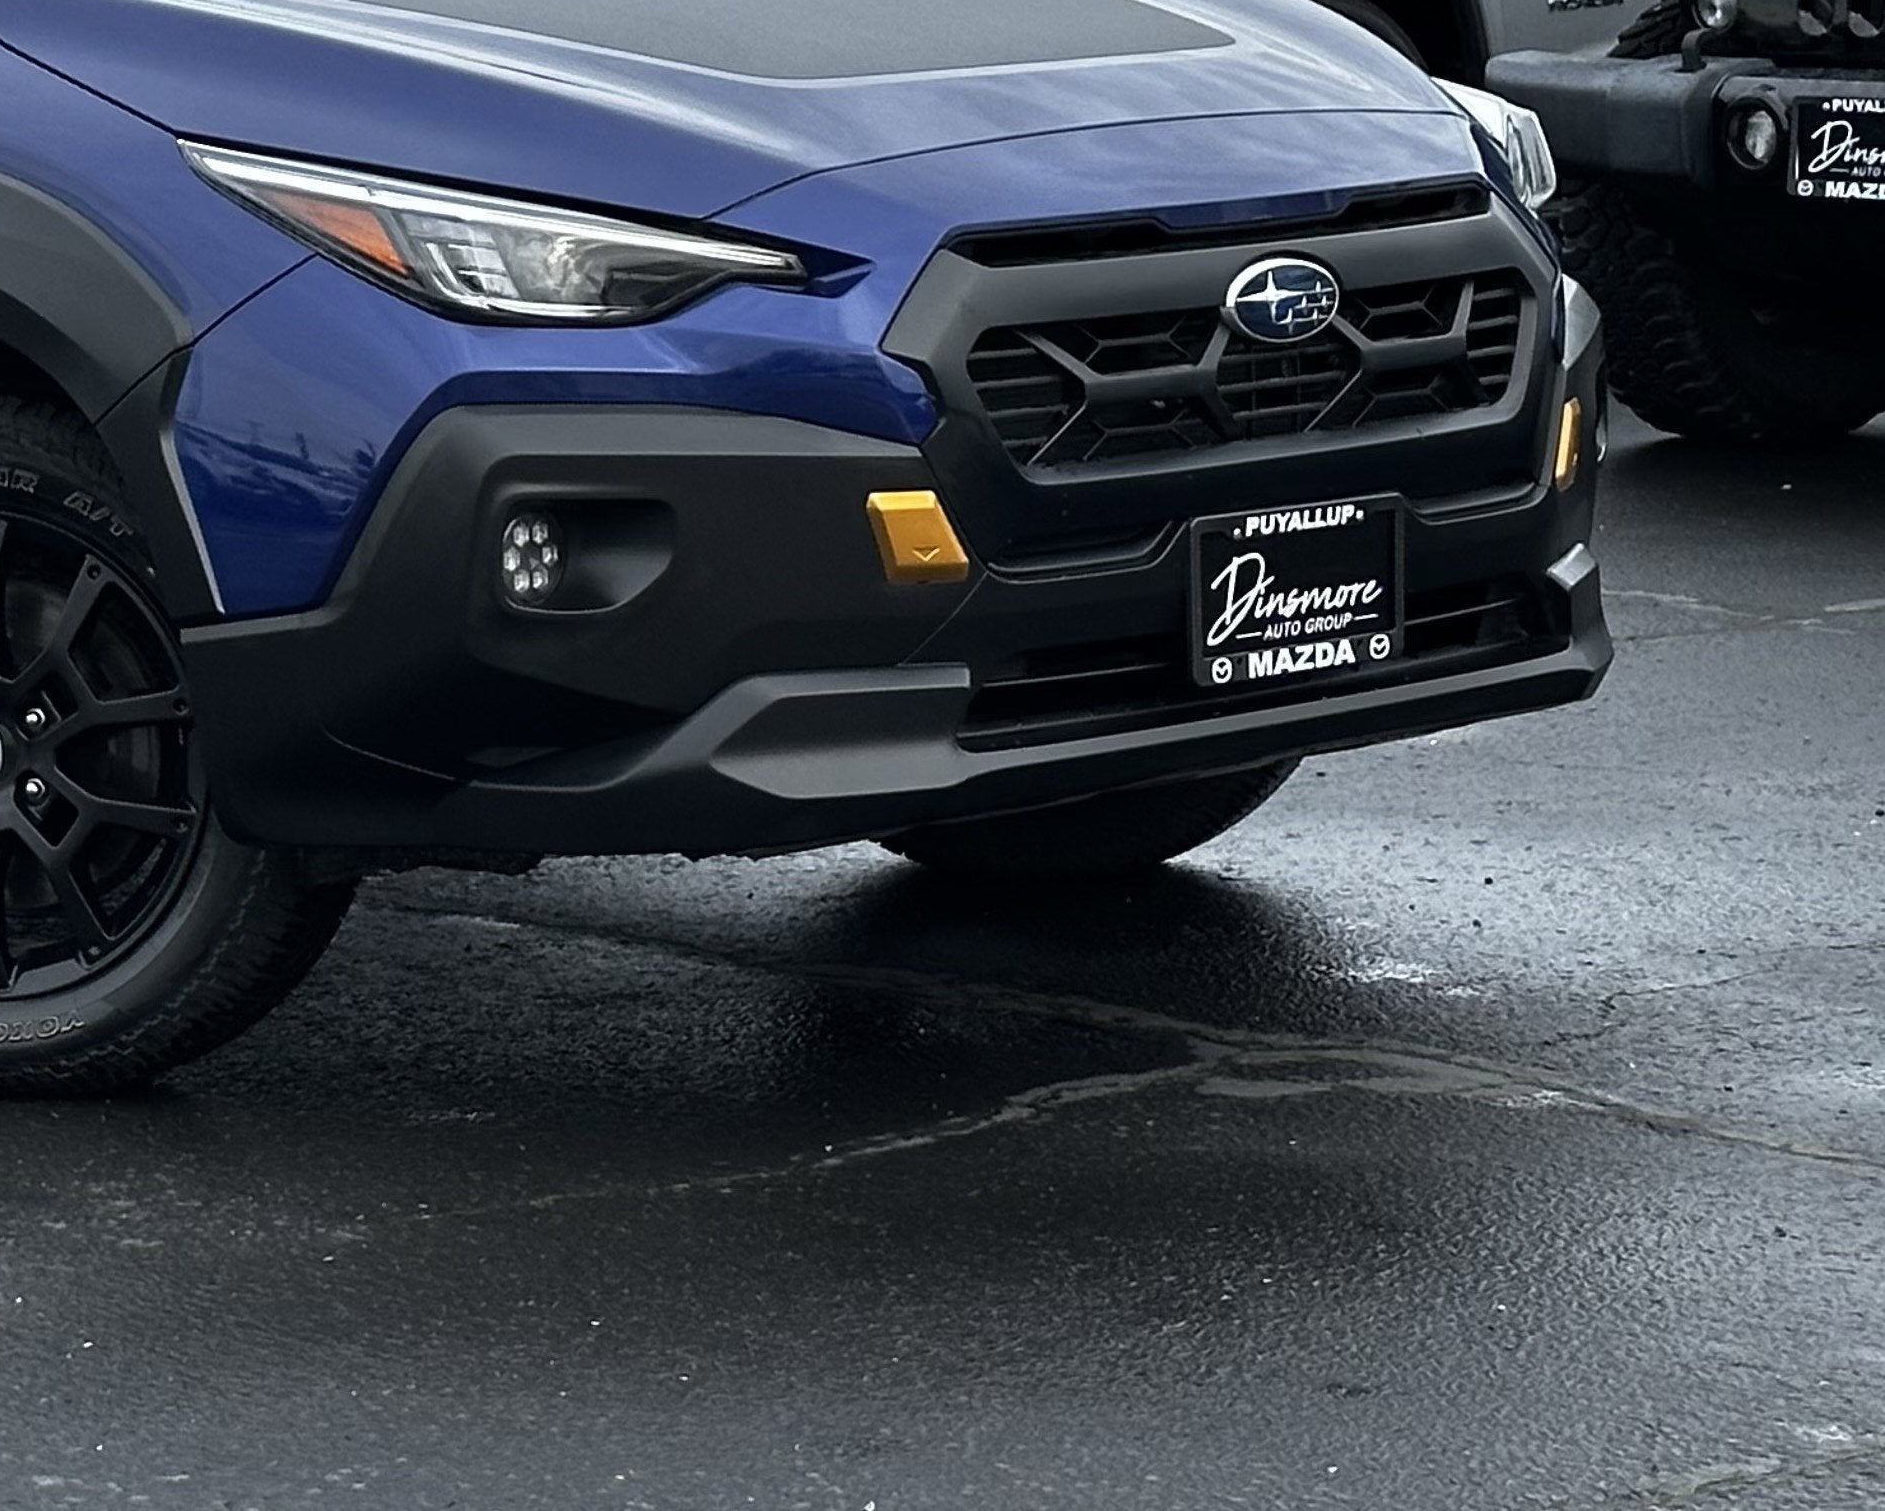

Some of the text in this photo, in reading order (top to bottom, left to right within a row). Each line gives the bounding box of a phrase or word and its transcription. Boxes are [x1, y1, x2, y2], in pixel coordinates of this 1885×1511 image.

[1832, 98, 1885, 113] PUYAL
[1851, 166, 1882, 177] AUTO
[1245, 504, 1355, 537] PUYALLUP
[1206, 552, 1383, 647] Dinsmore
[1263, 612, 1354, 641] AUTO GROUP
[1247, 639, 1356, 680] MAZDA
